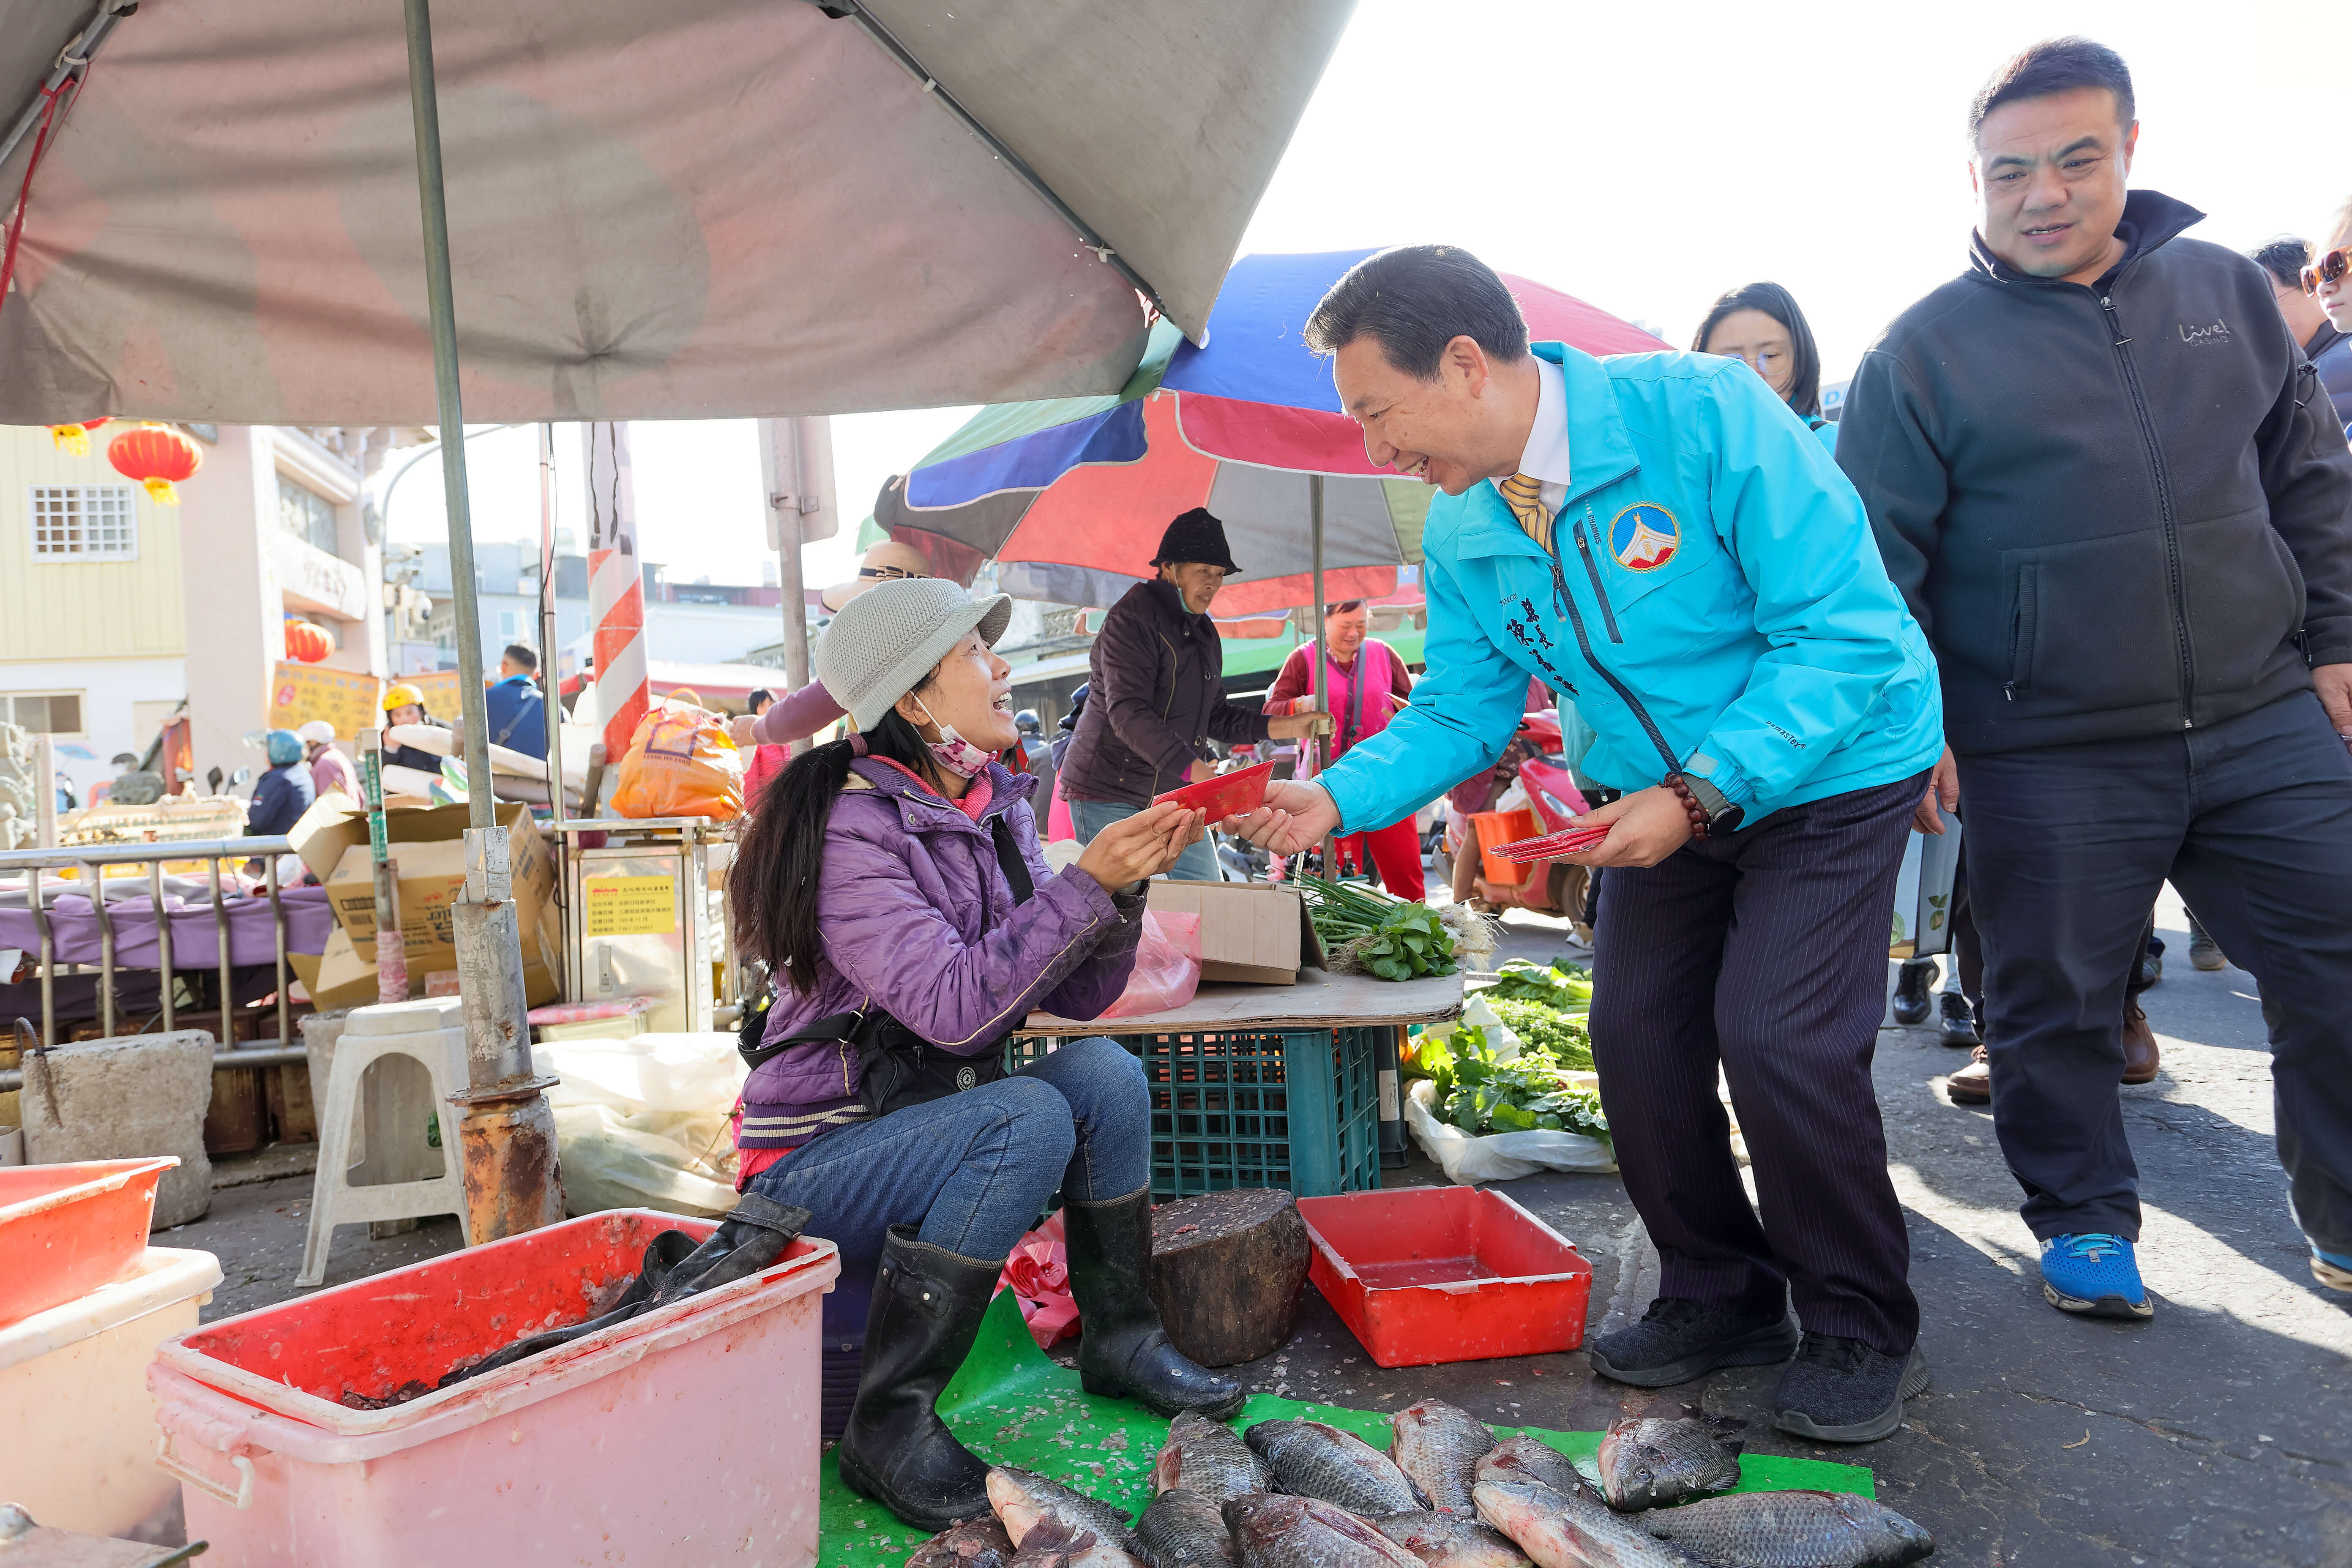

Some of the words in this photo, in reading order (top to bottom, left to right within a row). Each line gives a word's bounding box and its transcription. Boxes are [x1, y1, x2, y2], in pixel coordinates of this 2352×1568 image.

[2179, 319, 2229, 342] Live!
[2190, 336, 2228, 346] CASINO
[1587, 514, 1602, 544] CHAMOIS
